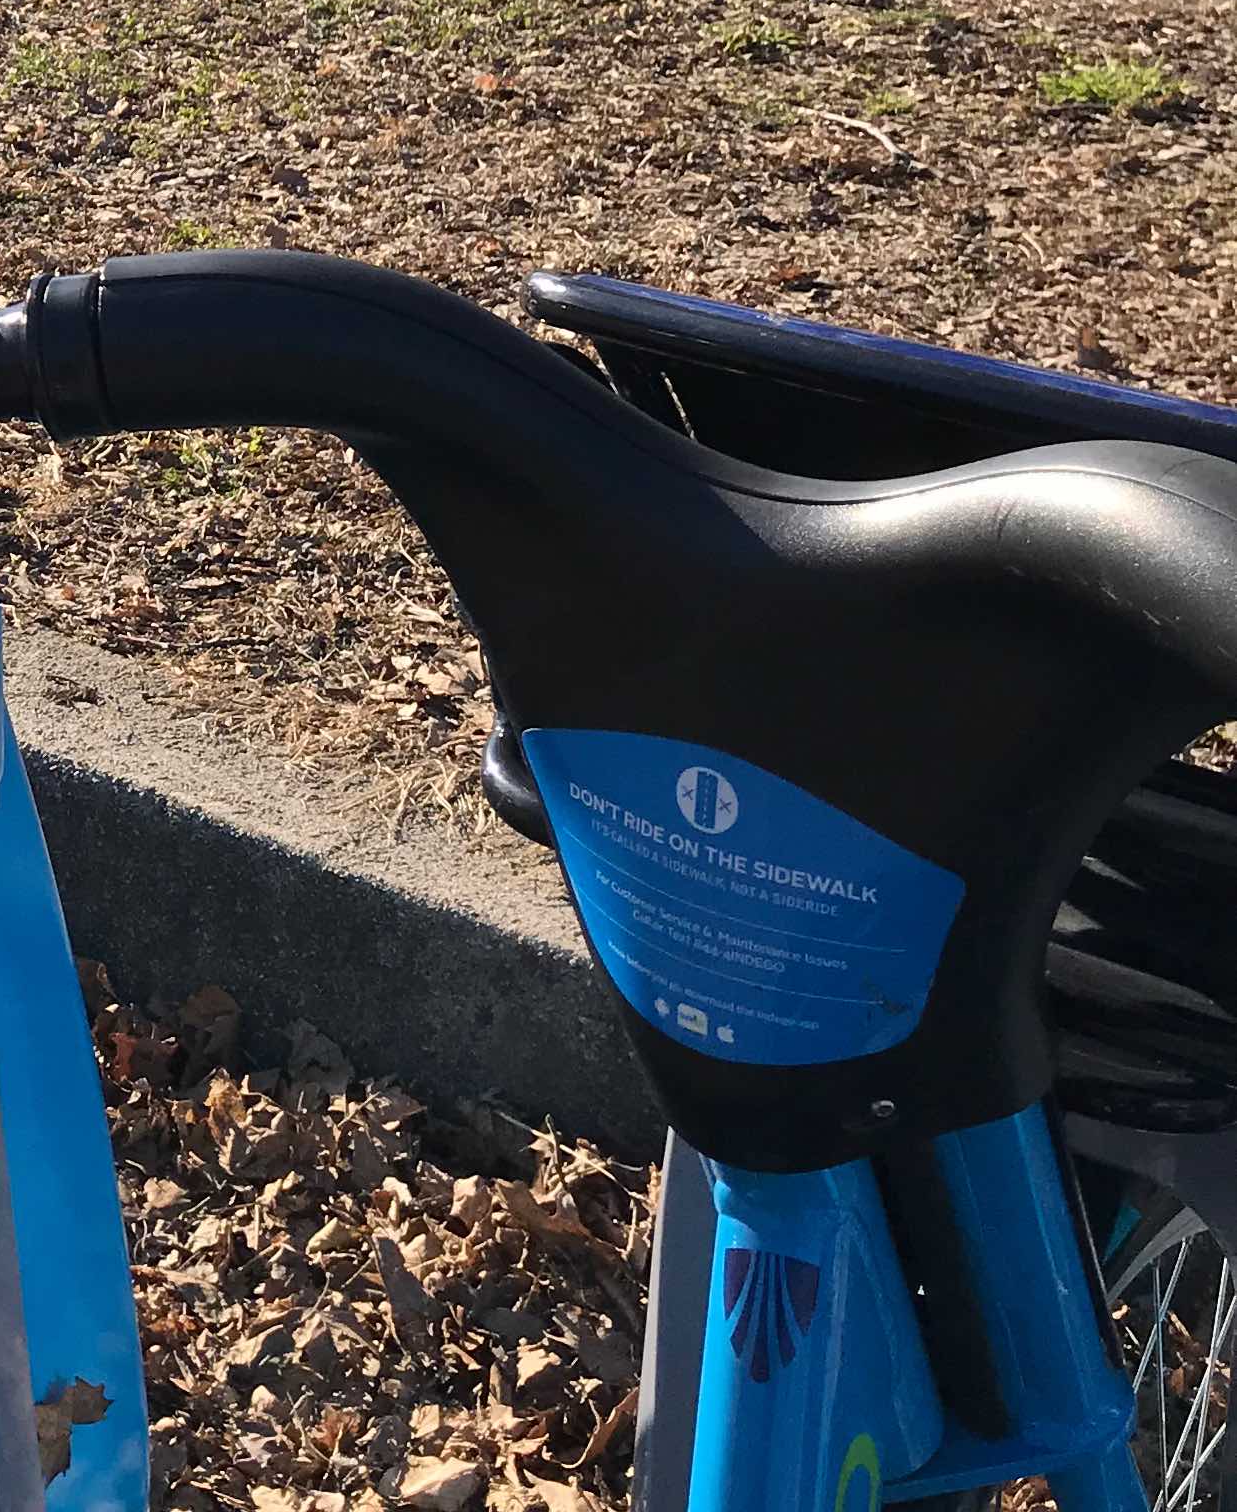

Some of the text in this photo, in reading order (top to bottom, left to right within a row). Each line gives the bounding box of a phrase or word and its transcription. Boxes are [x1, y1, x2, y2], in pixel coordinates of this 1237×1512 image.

[569, 782, 878, 904] DON'T RIDE ON THE SIDEWALK
[611, 830, 651, 858] CALLED
[730, 879, 755, 897] NOT
[759, 889, 769, 901] A
